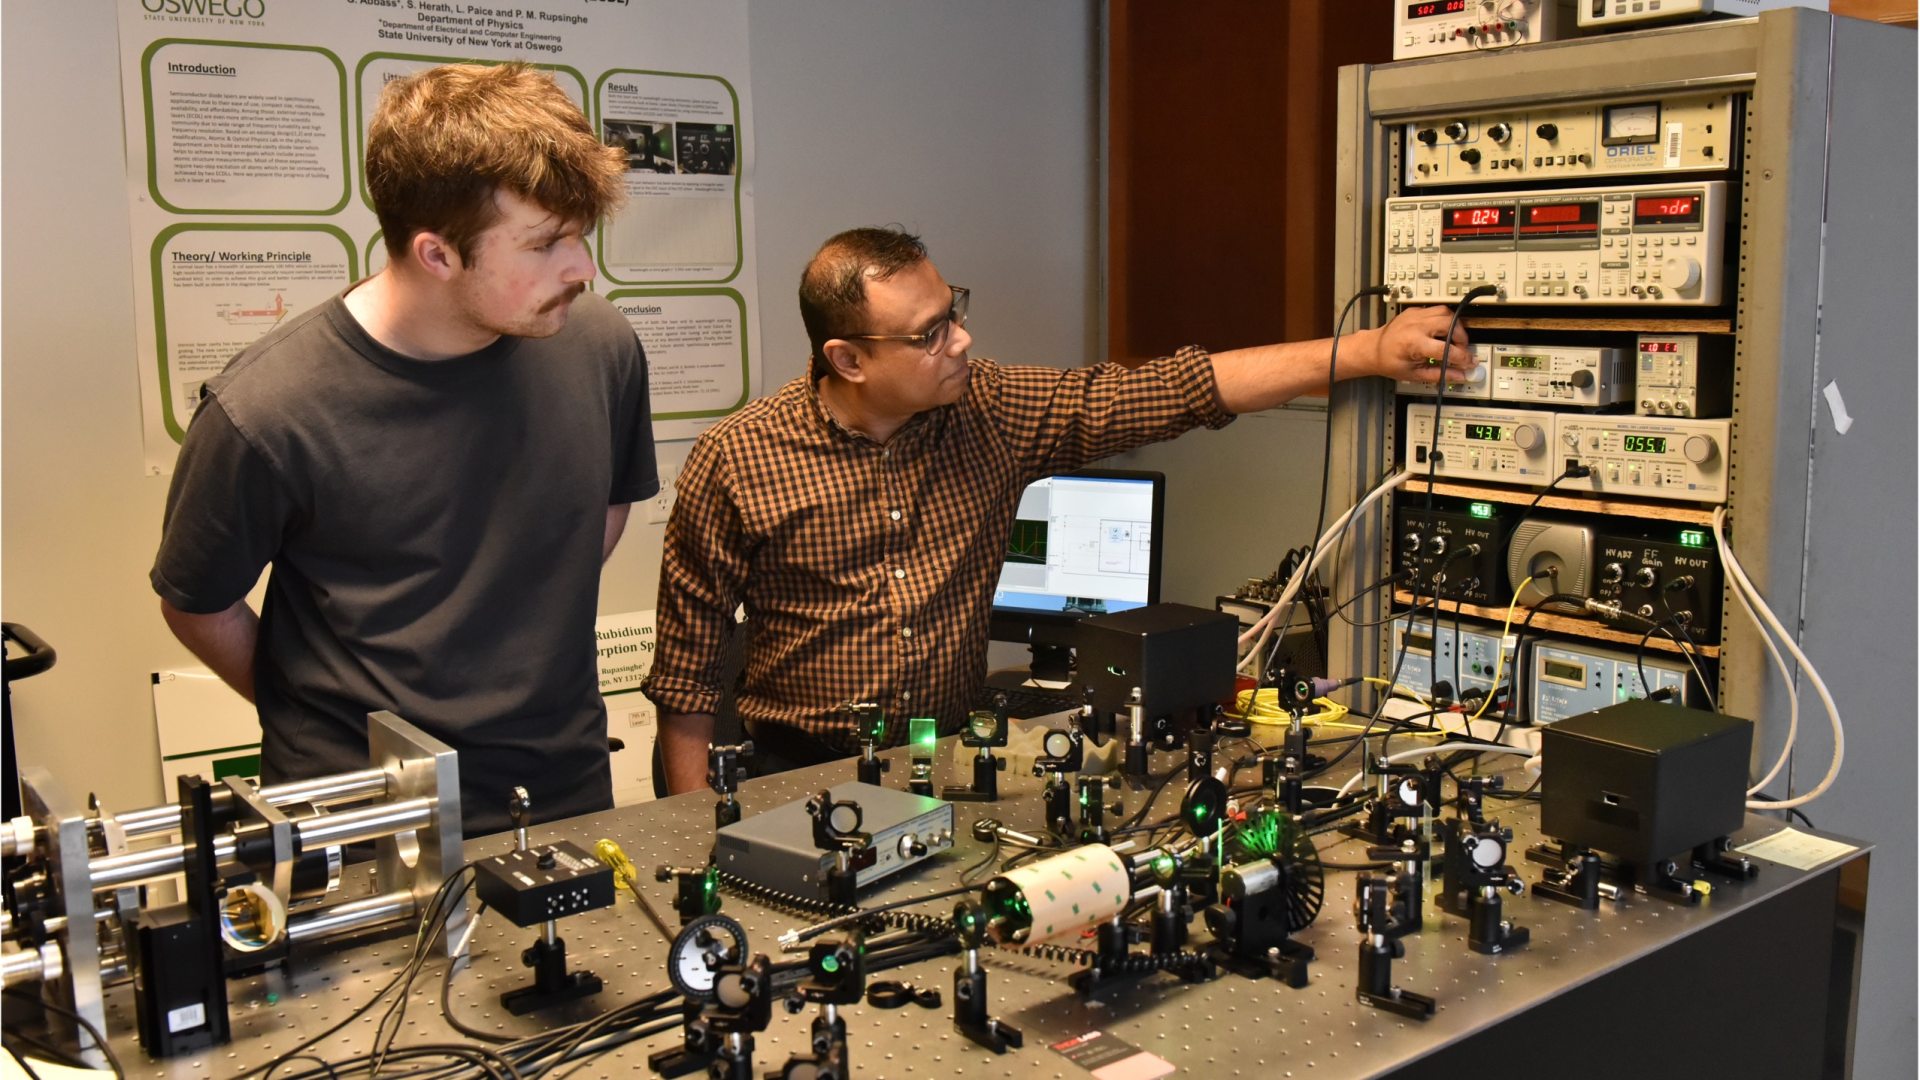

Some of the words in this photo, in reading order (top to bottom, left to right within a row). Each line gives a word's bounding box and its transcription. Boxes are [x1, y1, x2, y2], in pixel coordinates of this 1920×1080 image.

[420, 2, 453, 13] Herath,
[468, 6, 493, 16] Paice
[496, 8, 512, 18] and
[540, 12, 588, 24] Rupsinghe
[169, 16, 214, 24] UNIVERSITY
[418, 12, 472, 24] Department
[487, 18, 524, 30] Physics
[435, 25, 468, 34] Electrical
[485, 29, 518, 39] Computer
[521, 32, 561, 42] Engineering
[378, 30, 403, 39] State
[406, 32, 453, 45] University
[456, 36, 465, 44] of
[468, 37, 488, 46] New
[491, 39, 512, 48] York
[525, 41, 563, 53] Oswego
[168, 62, 236, 74] Introduction
[608, 82, 638, 92] Results
[1607, 144, 1655, 157] ORIEL
[1472, 210, 1499, 224] 0.24
[172, 251, 215, 262] Theory/
[219, 252, 264, 262] Working
[266, 252, 311, 262] Principle
[618, 304, 662, 314] Conclusion
[1465, 528, 1475, 536] HV
[1605, 548, 1616, 556] HV
[1644, 549, 1659, 559] FF
[1675, 556, 1687, 566] HV
[1690, 558, 1708, 568] OUT
[596, 626, 653, 640] Rubidium
